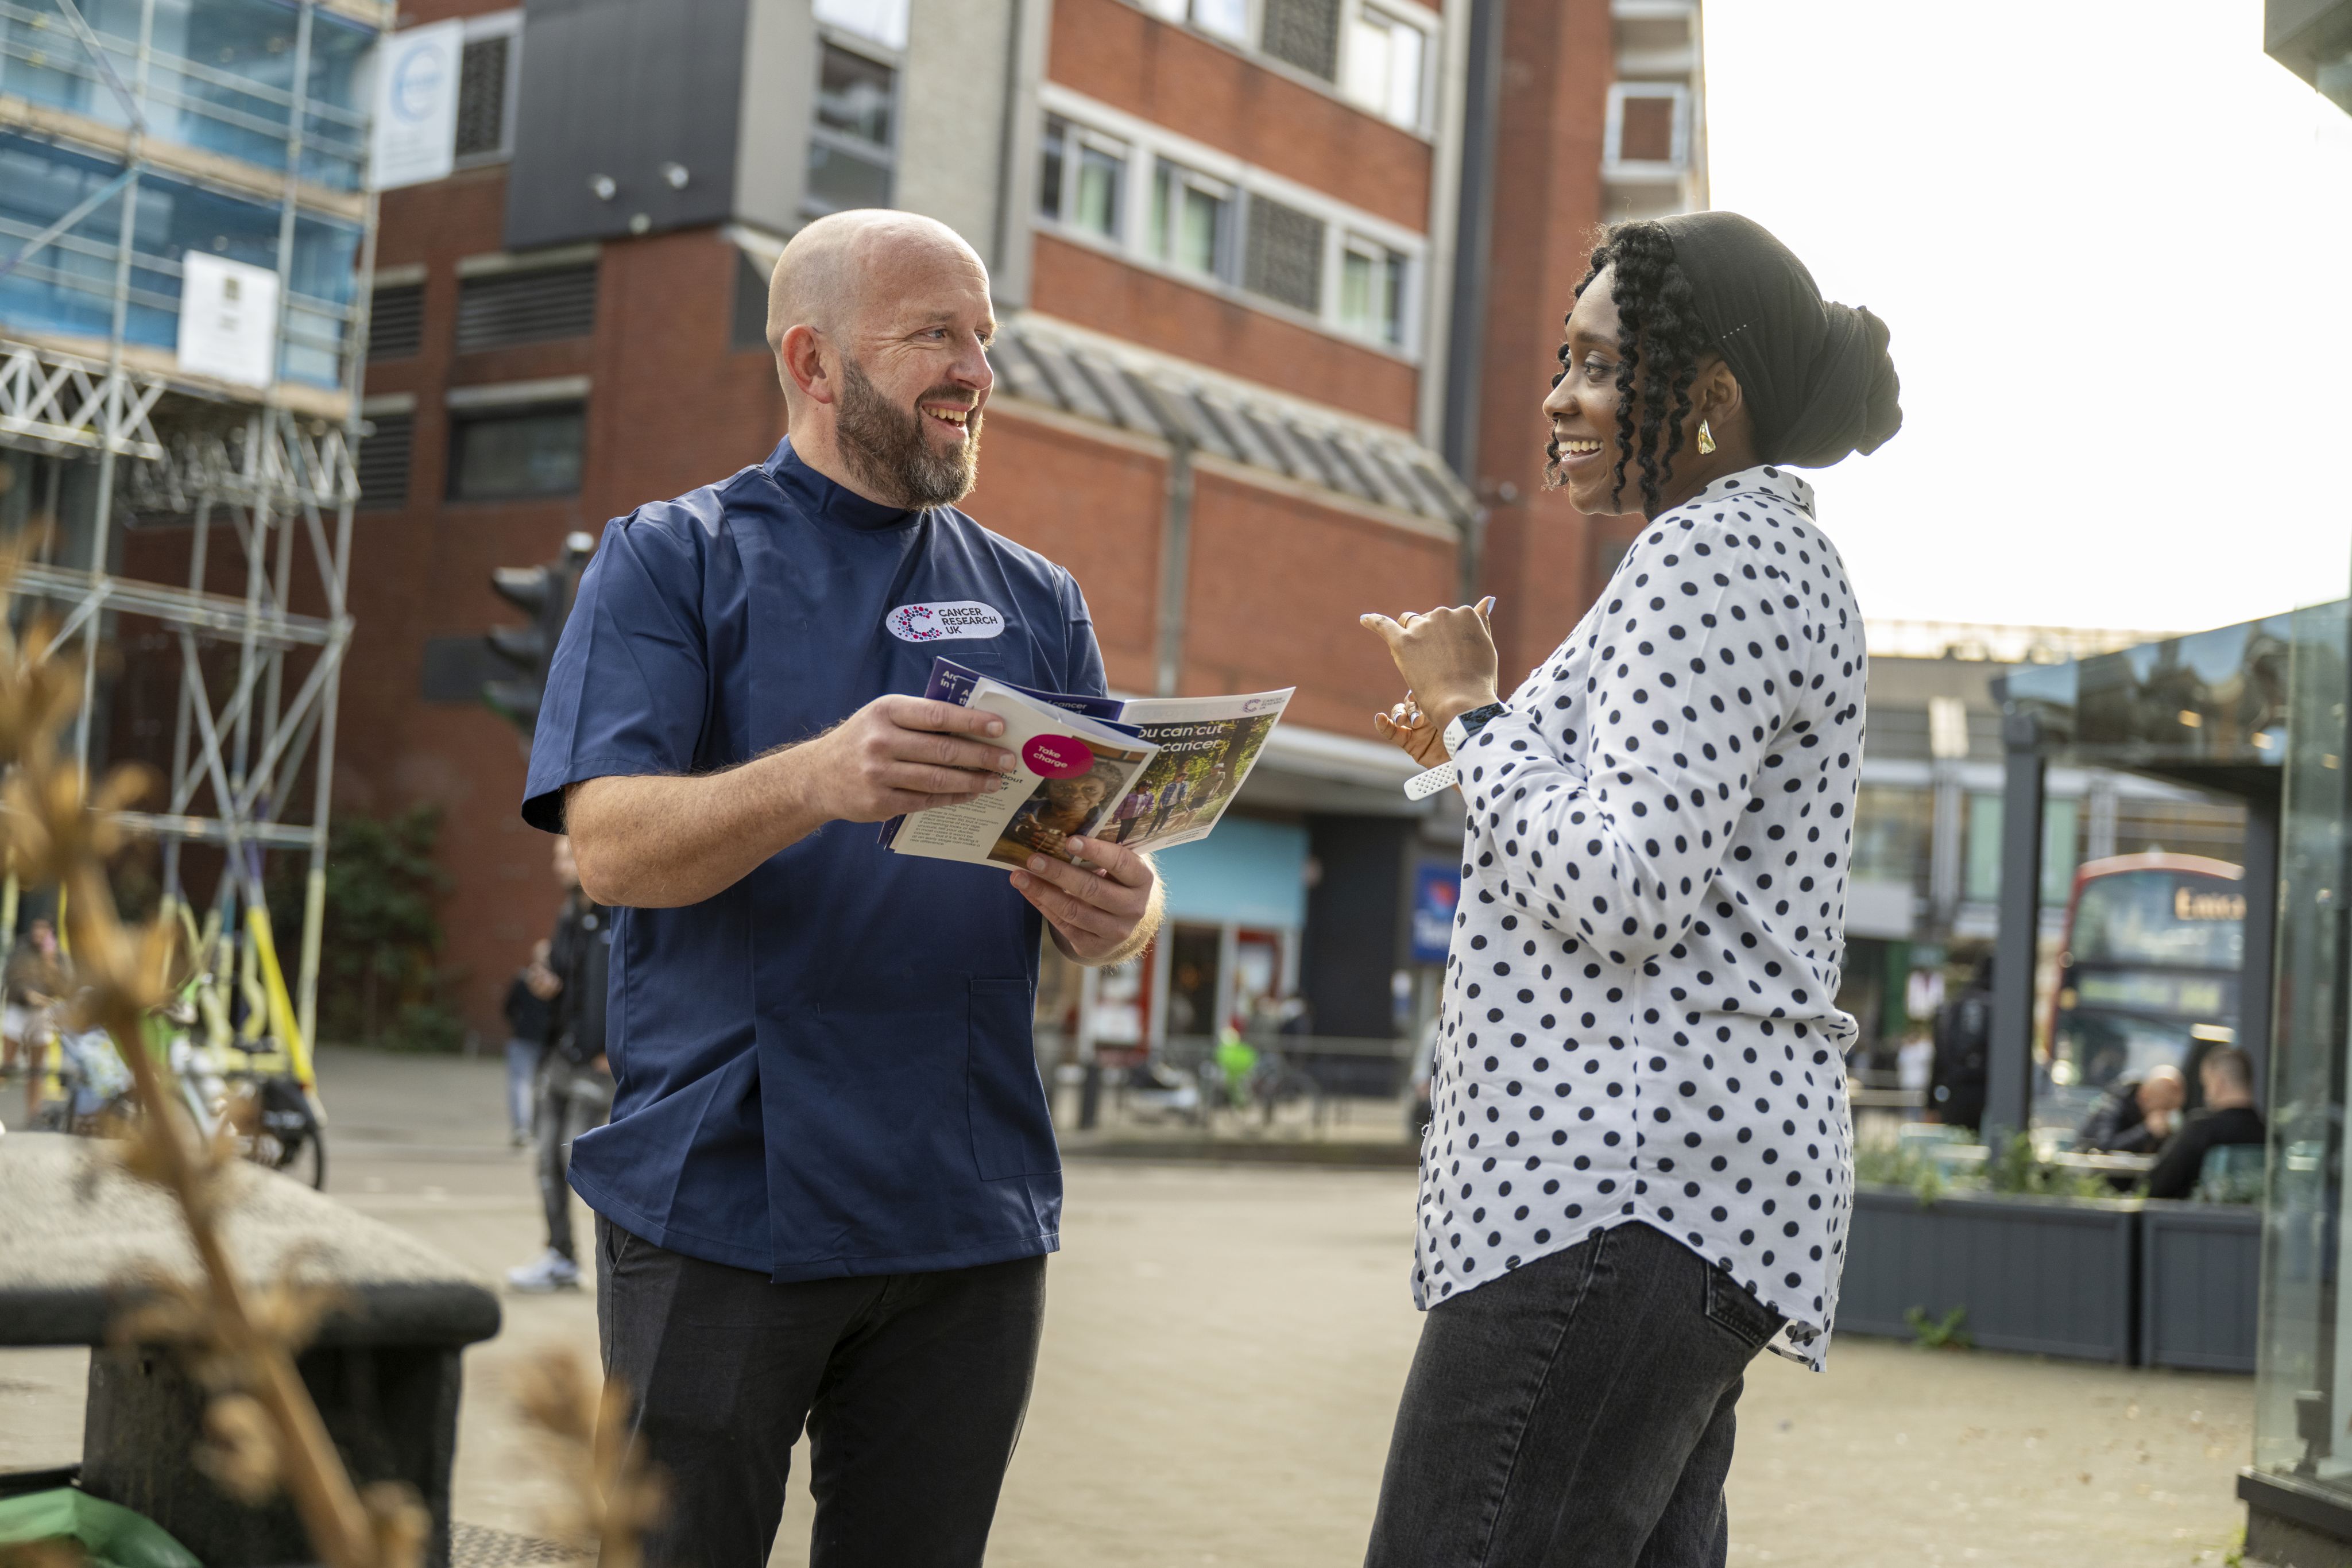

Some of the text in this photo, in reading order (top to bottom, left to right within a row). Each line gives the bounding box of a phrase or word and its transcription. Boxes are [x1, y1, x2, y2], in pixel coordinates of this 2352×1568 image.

[938, 607, 982, 617] CANCER
[941, 616, 999, 626] RESEARCH
[945, 626, 962, 634] UK
[1160, 727, 1193, 738] can
[1196, 723, 1223, 735] cut
[1038, 745, 1061, 758] Take
[1160, 738, 1223, 753] cancer
[1033, 753, 1068, 768] charge
